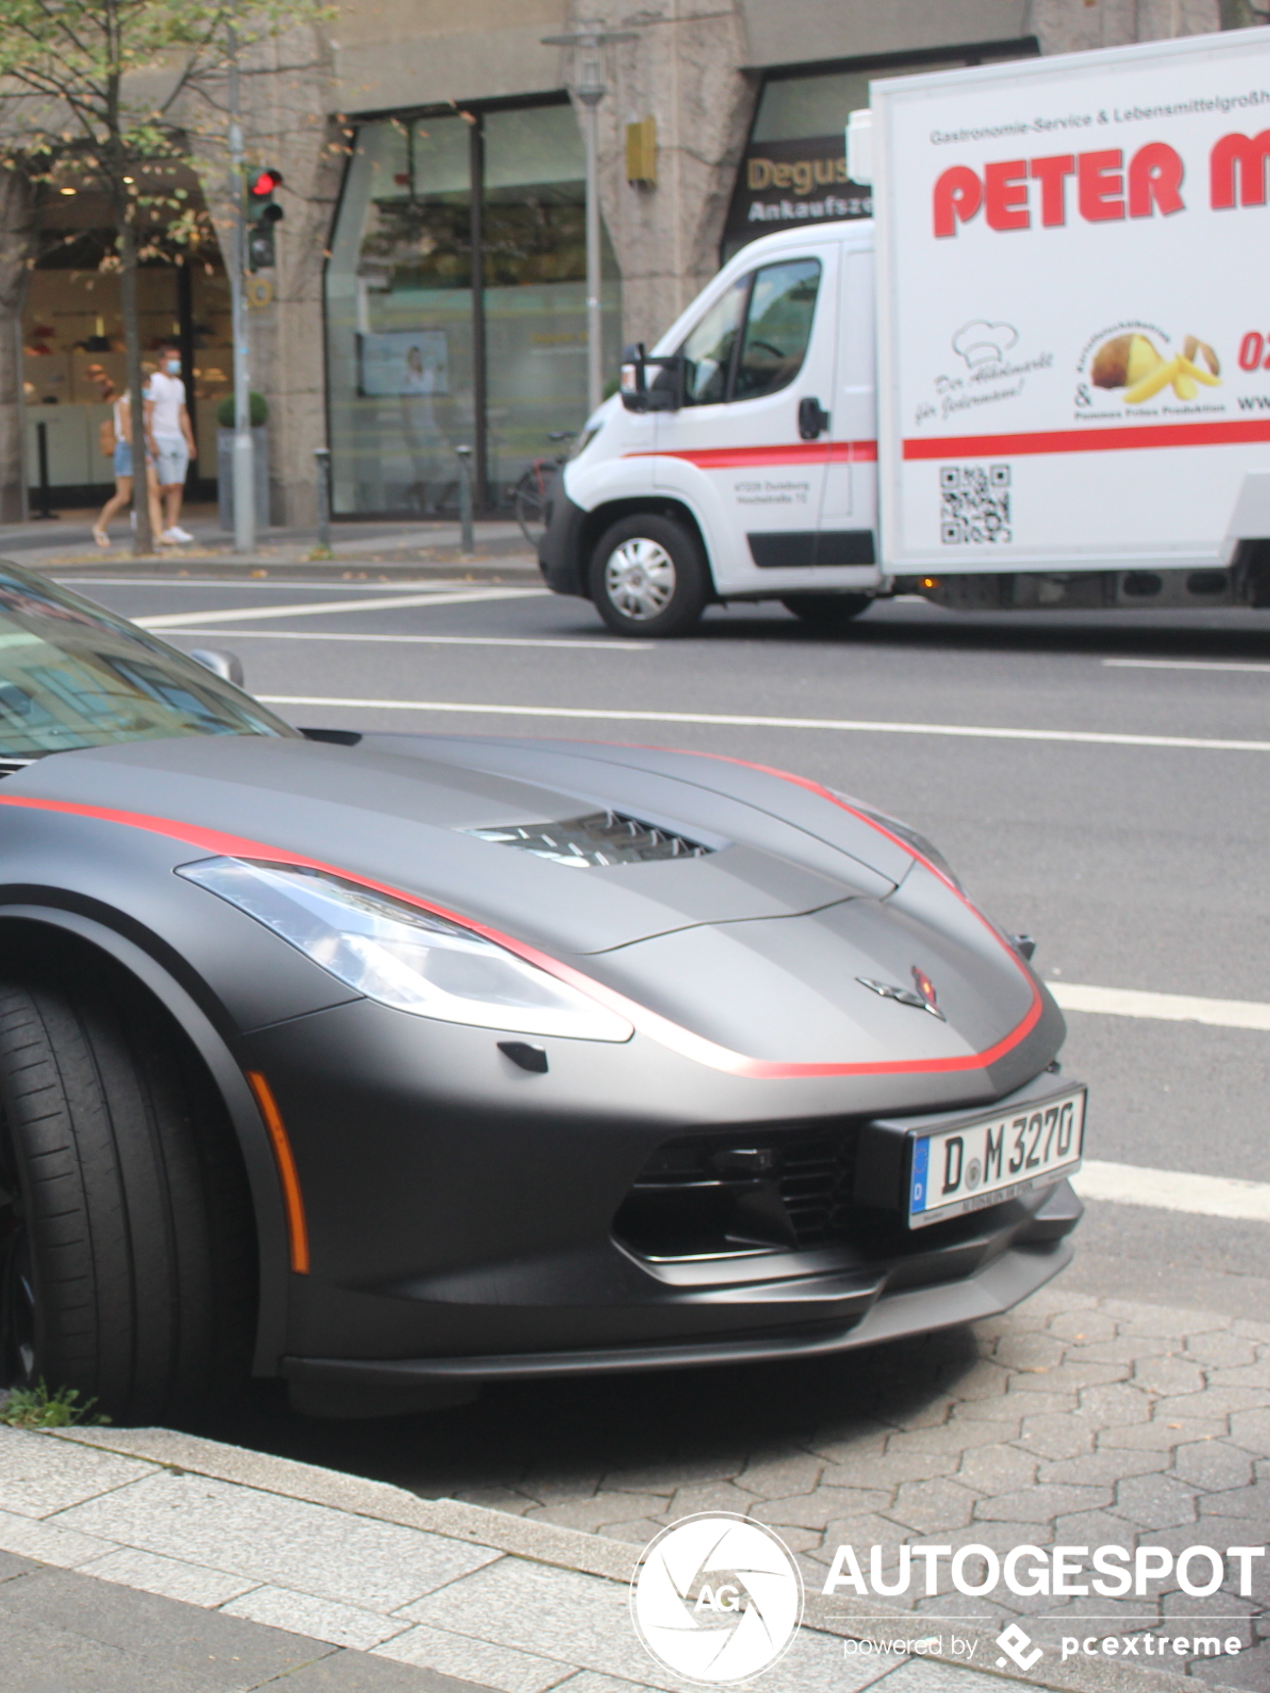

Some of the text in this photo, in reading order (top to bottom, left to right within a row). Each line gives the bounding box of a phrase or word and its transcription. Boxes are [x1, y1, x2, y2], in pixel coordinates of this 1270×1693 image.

[930, 114, 1092, 145] Gastronomie-Service
[1097, 109, 1109, 124] &
[933, 142, 1186, 238] PETER
[1074, 382, 1092, 408] &
[942, 1135, 964, 1195] D
[913, 1183, 923, 1201] D
